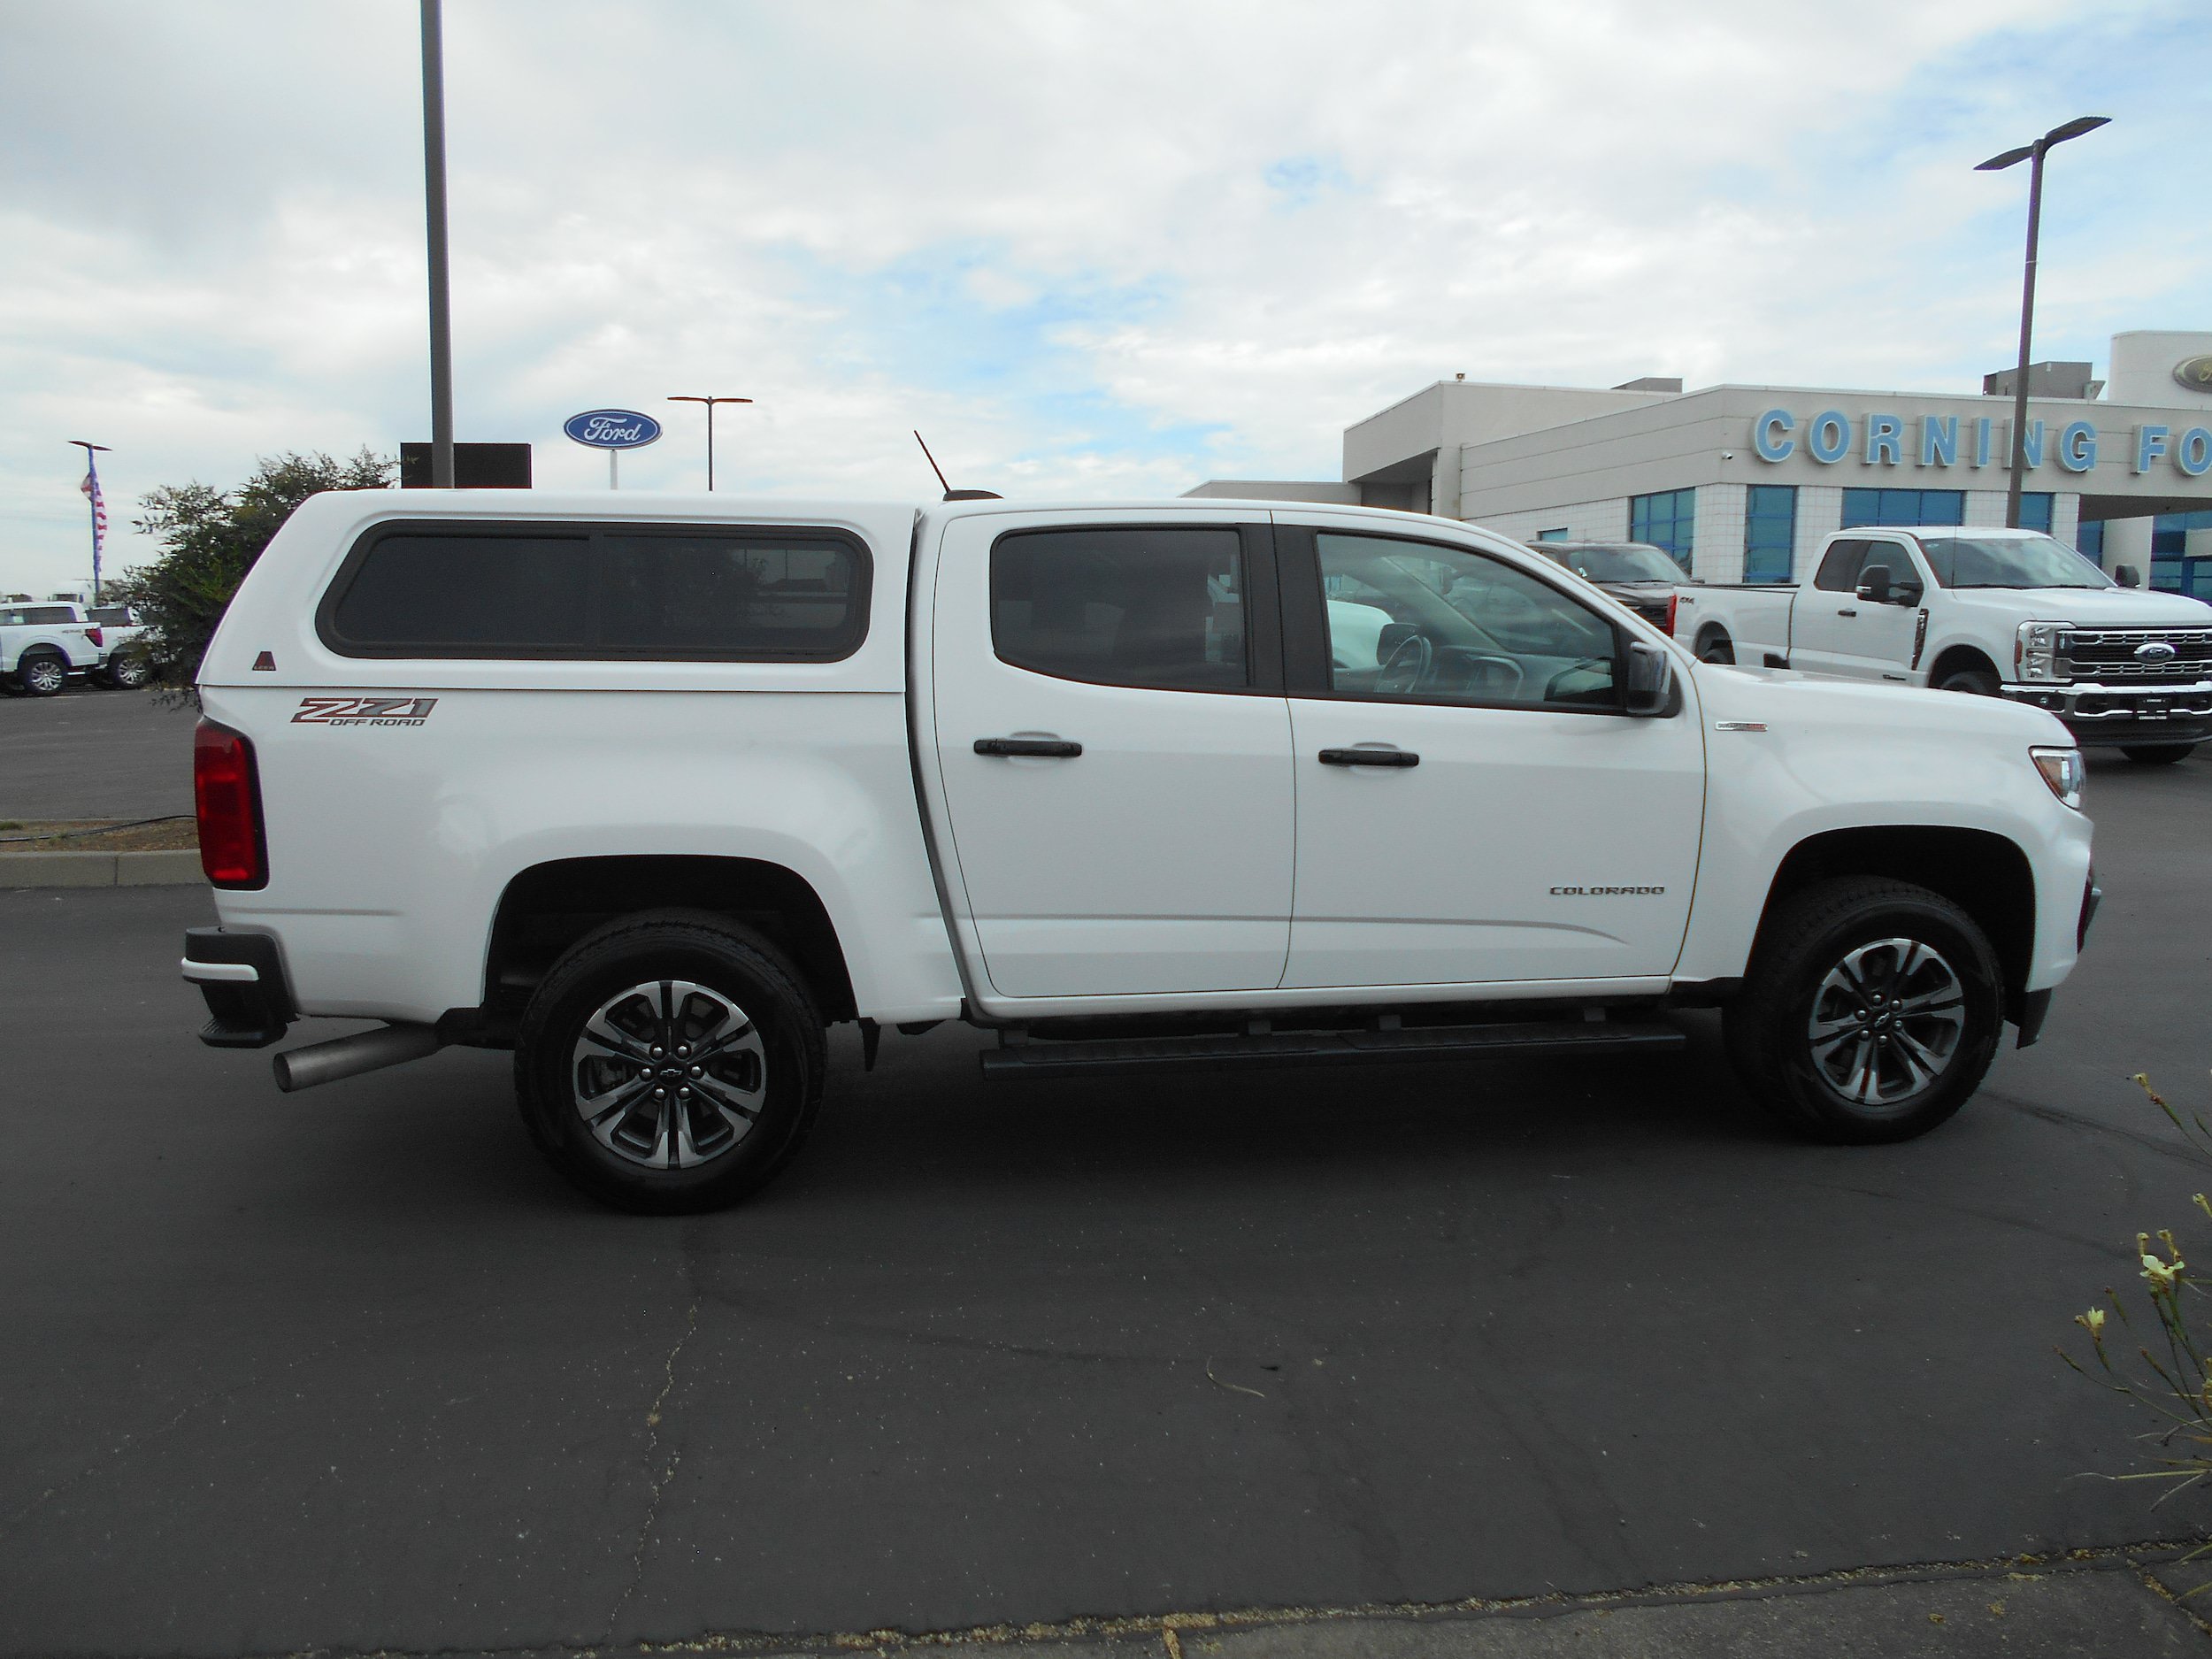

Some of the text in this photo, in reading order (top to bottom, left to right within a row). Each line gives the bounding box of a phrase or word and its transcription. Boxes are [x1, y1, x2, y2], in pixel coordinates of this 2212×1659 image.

[584, 417, 642, 441] Ford
[1753, 408, 2098, 472] CORNING
[290, 697, 439, 723] Z71
[1549, 886, 1665, 895] COLORADO
